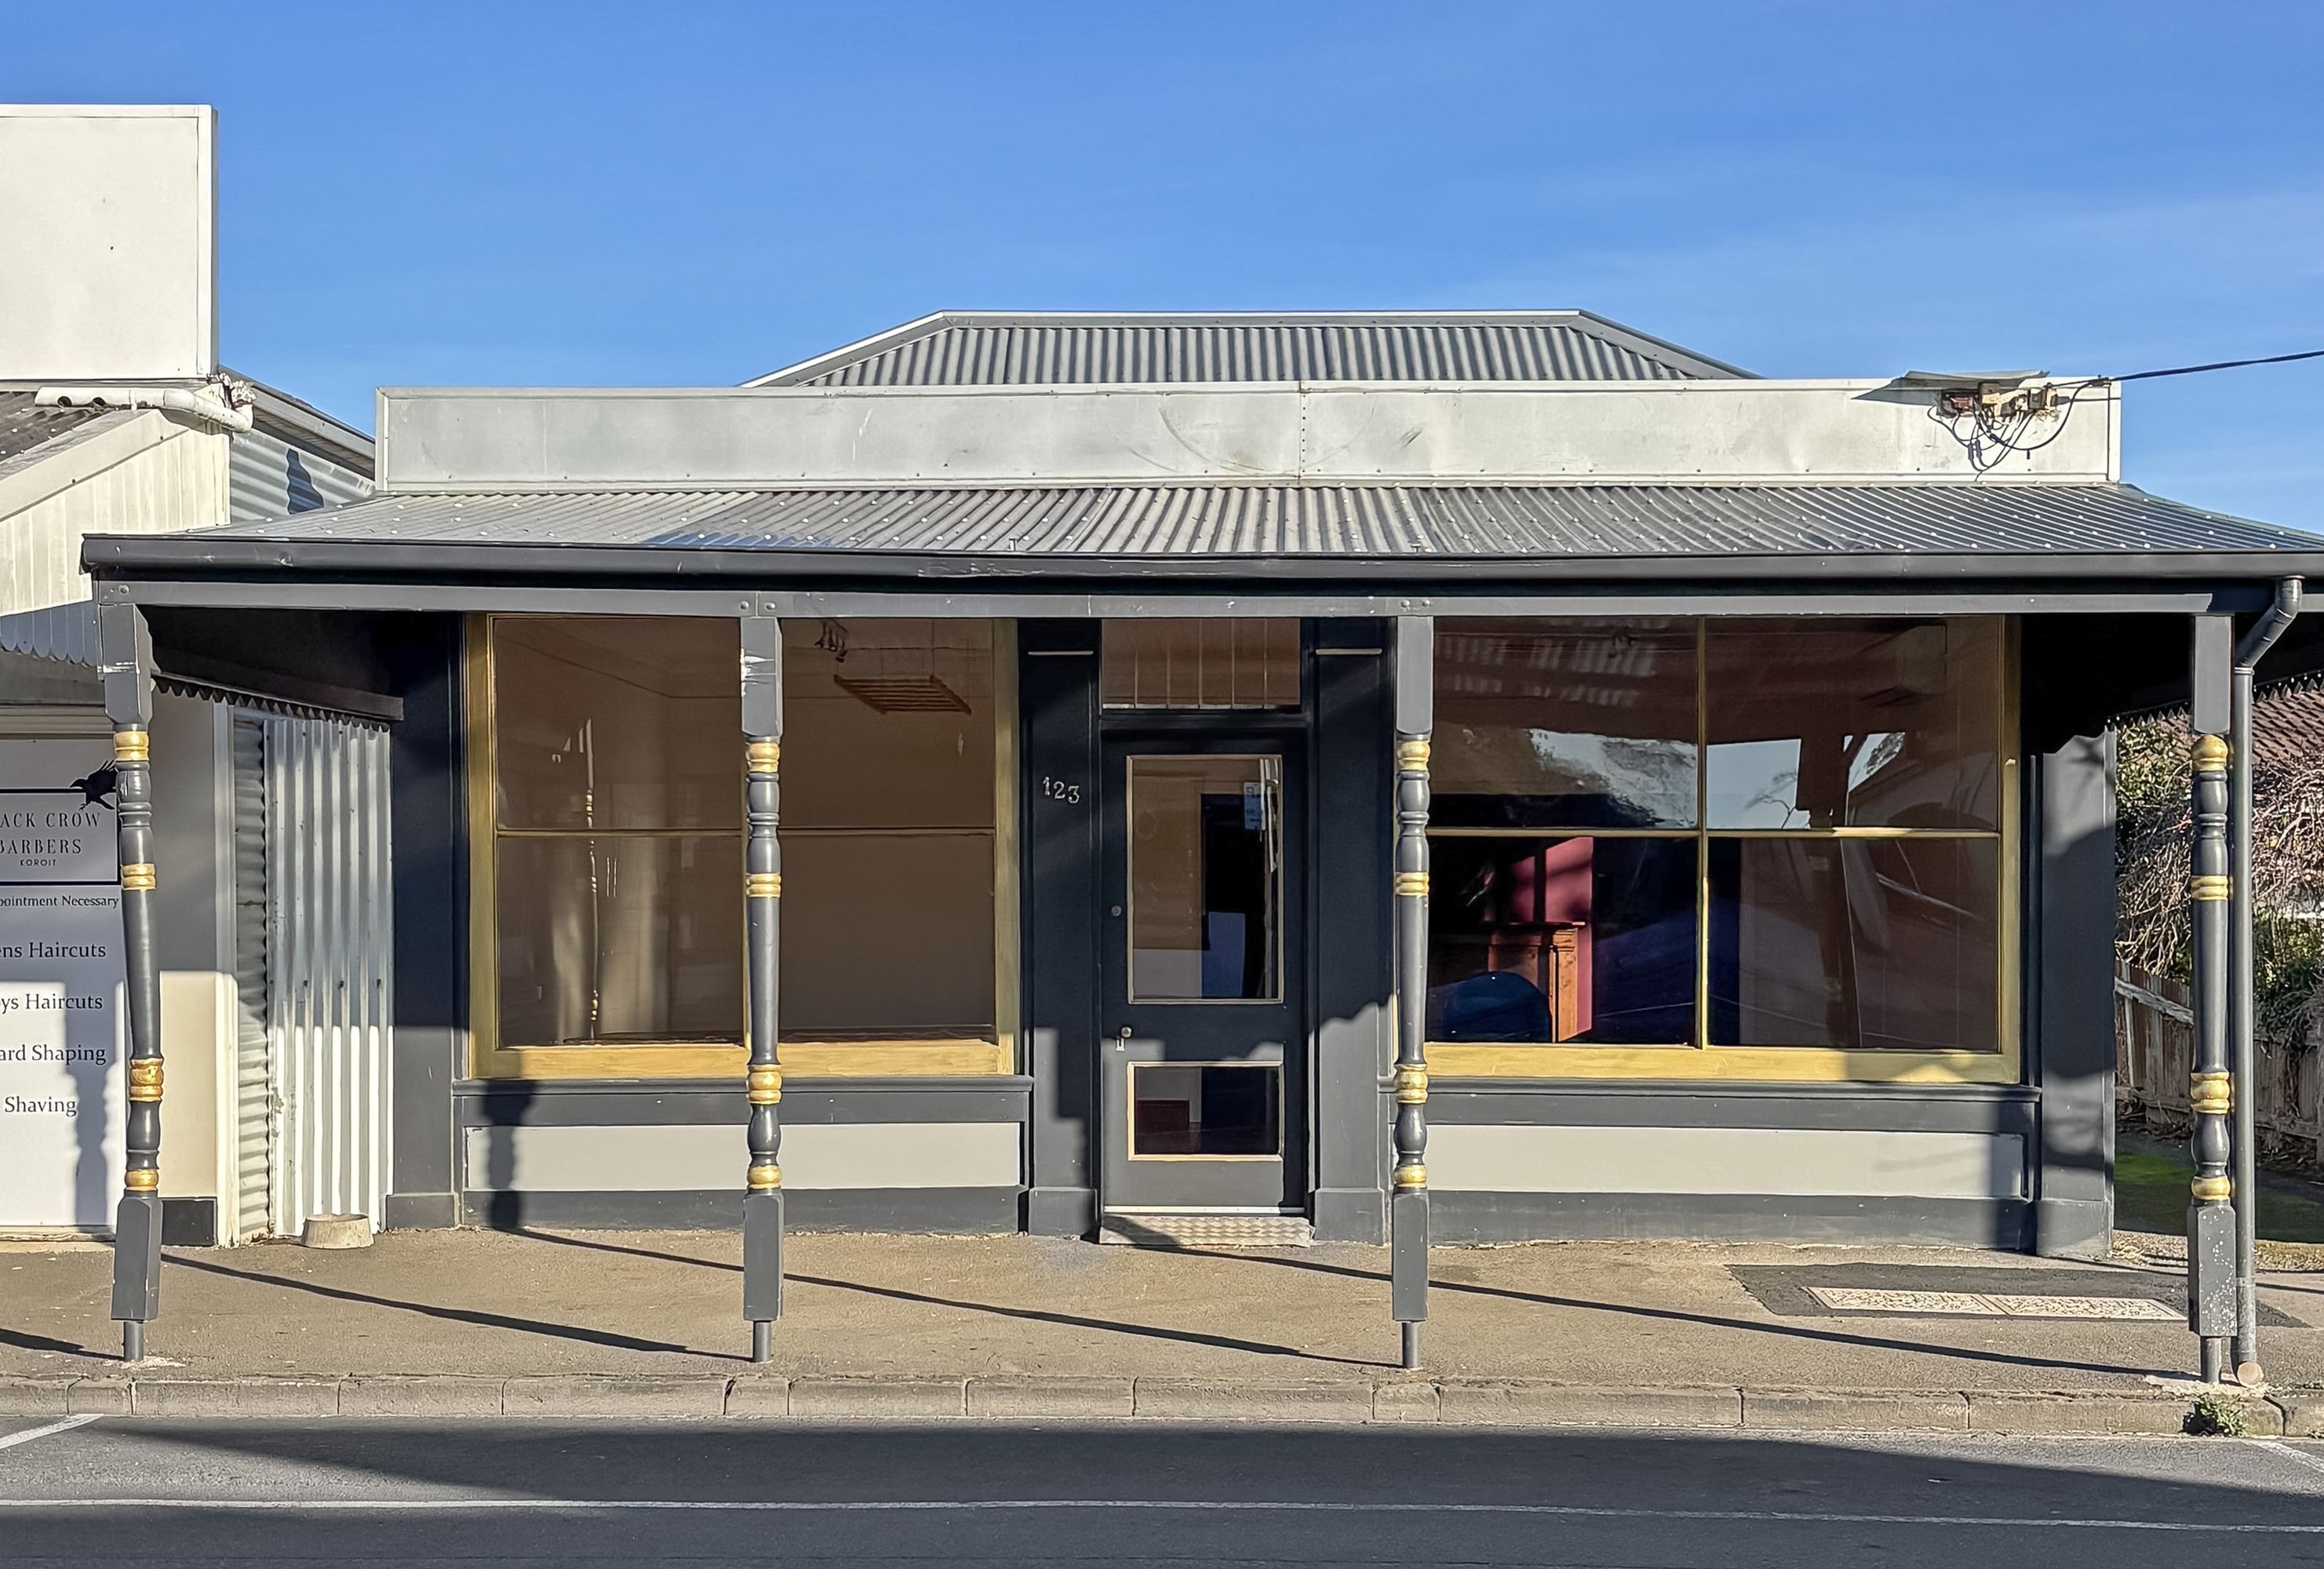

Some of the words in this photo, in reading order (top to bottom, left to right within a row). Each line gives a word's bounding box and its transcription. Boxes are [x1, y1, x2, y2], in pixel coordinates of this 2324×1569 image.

[1043, 777, 1080, 803] 123
[46, 812, 100, 828] CROW
[62, 895, 119, 909] Necessary
[0, 946, 23, 958] ns
[29, 941, 107, 958] Haircuts
[0, 998, 19, 1014] ys
[26, 993, 103, 1010] Haircuts
[32, 1044, 106, 1065] Shaping
[5, 1096, 77, 1116] Shaving
